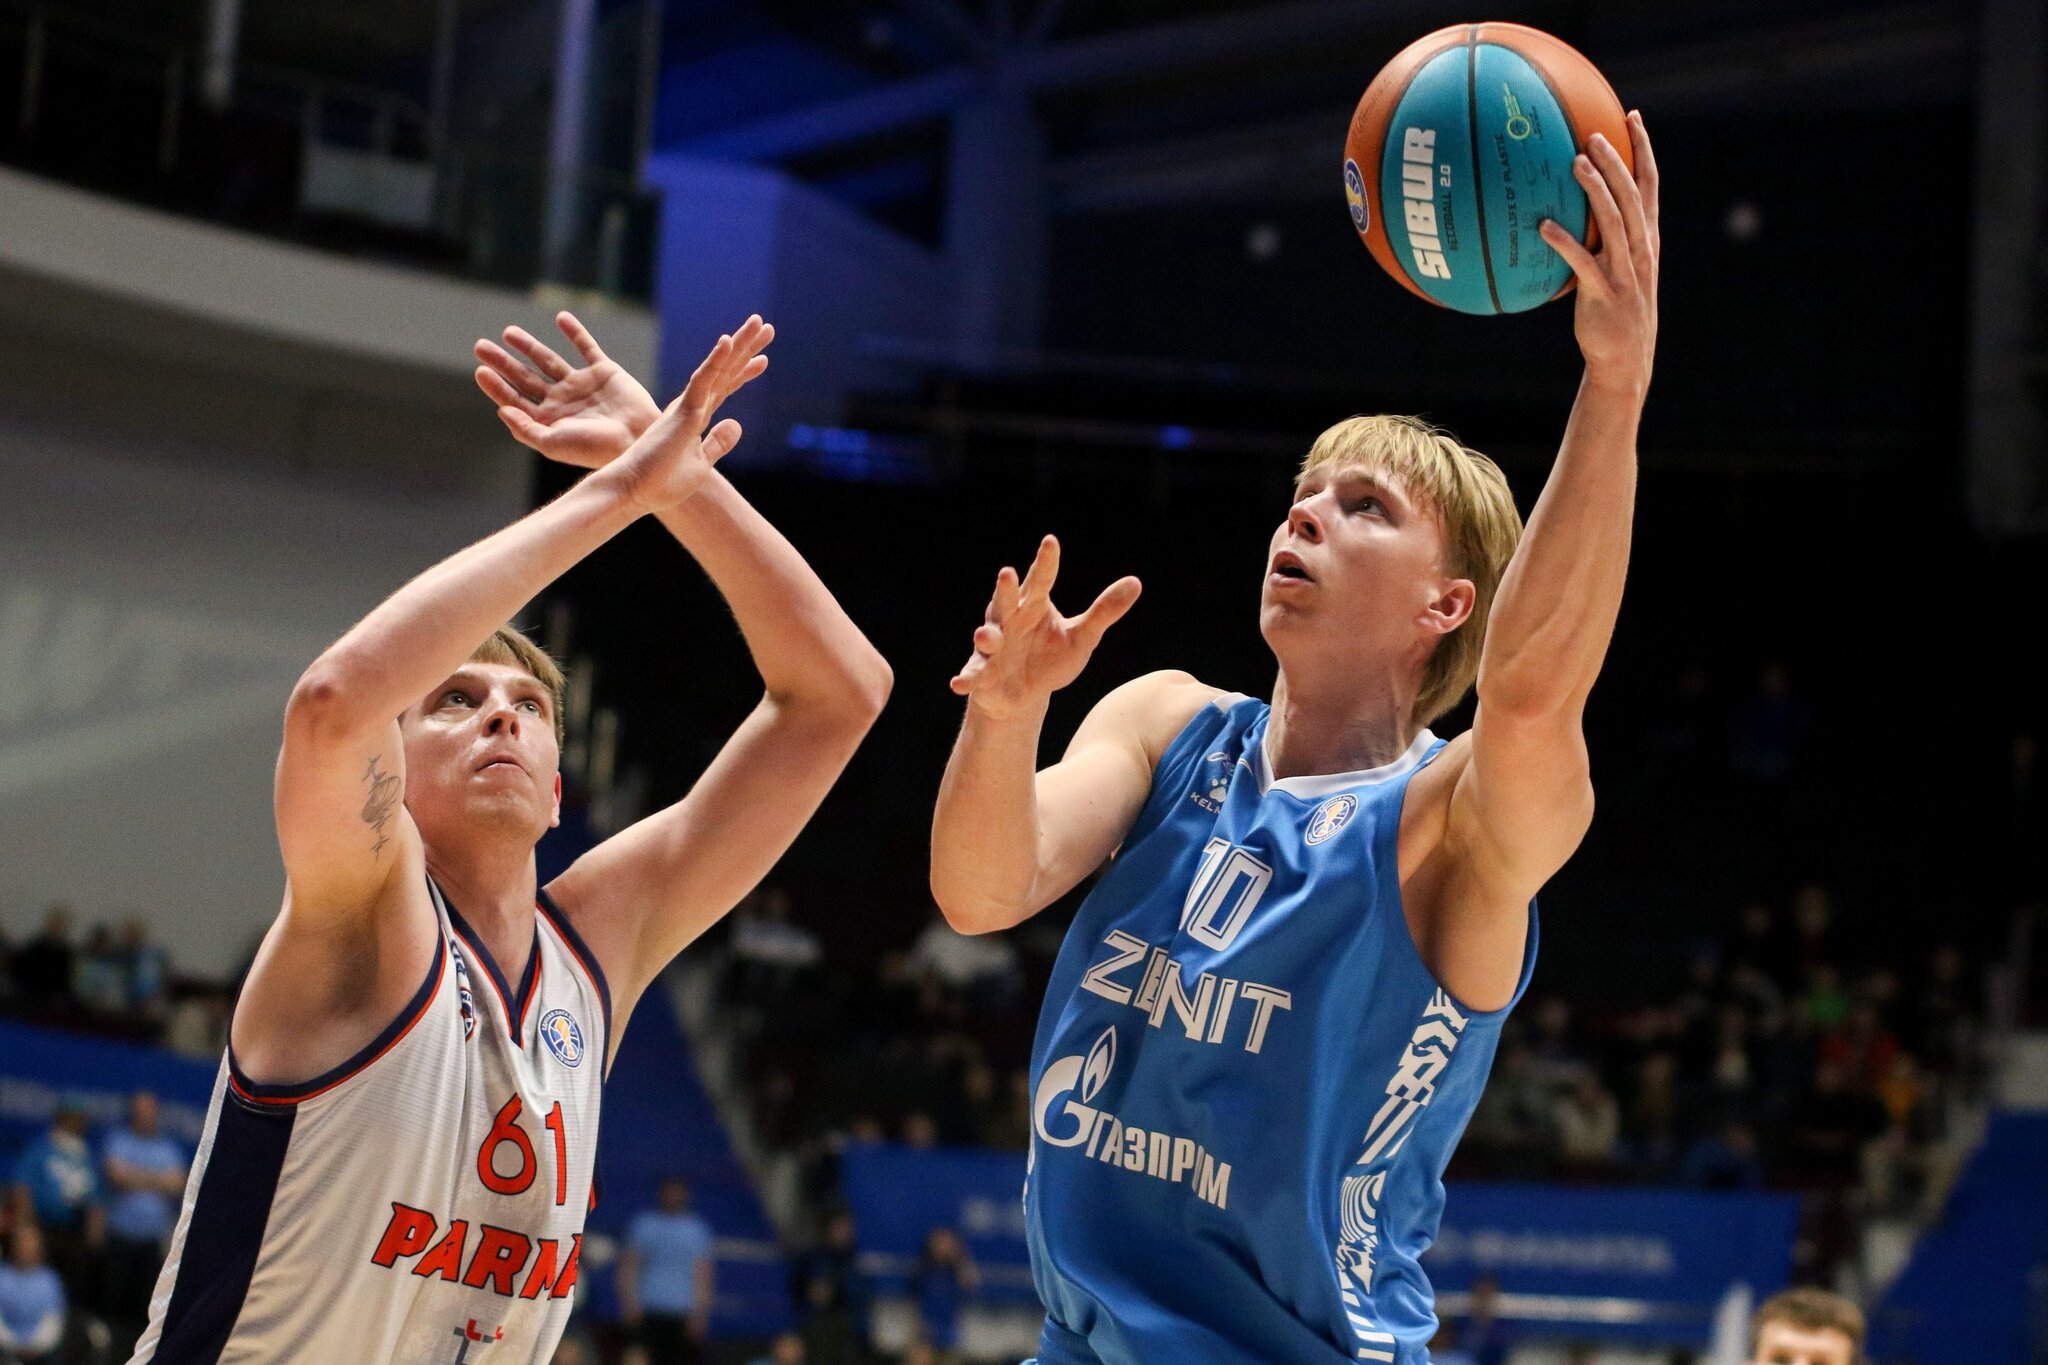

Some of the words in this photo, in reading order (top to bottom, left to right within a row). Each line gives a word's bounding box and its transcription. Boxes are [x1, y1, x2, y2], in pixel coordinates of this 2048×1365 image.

[1402, 127, 1452, 279] SIBUR
[1440, 164, 1451, 187] 2.0
[1505, 186, 1516, 200] OF
[1508, 203, 1518, 228] LIFE
[1178, 836, 1274, 952] 10
[1080, 929, 1292, 1054] ZENIT
[477, 1092, 567, 1206] 61
